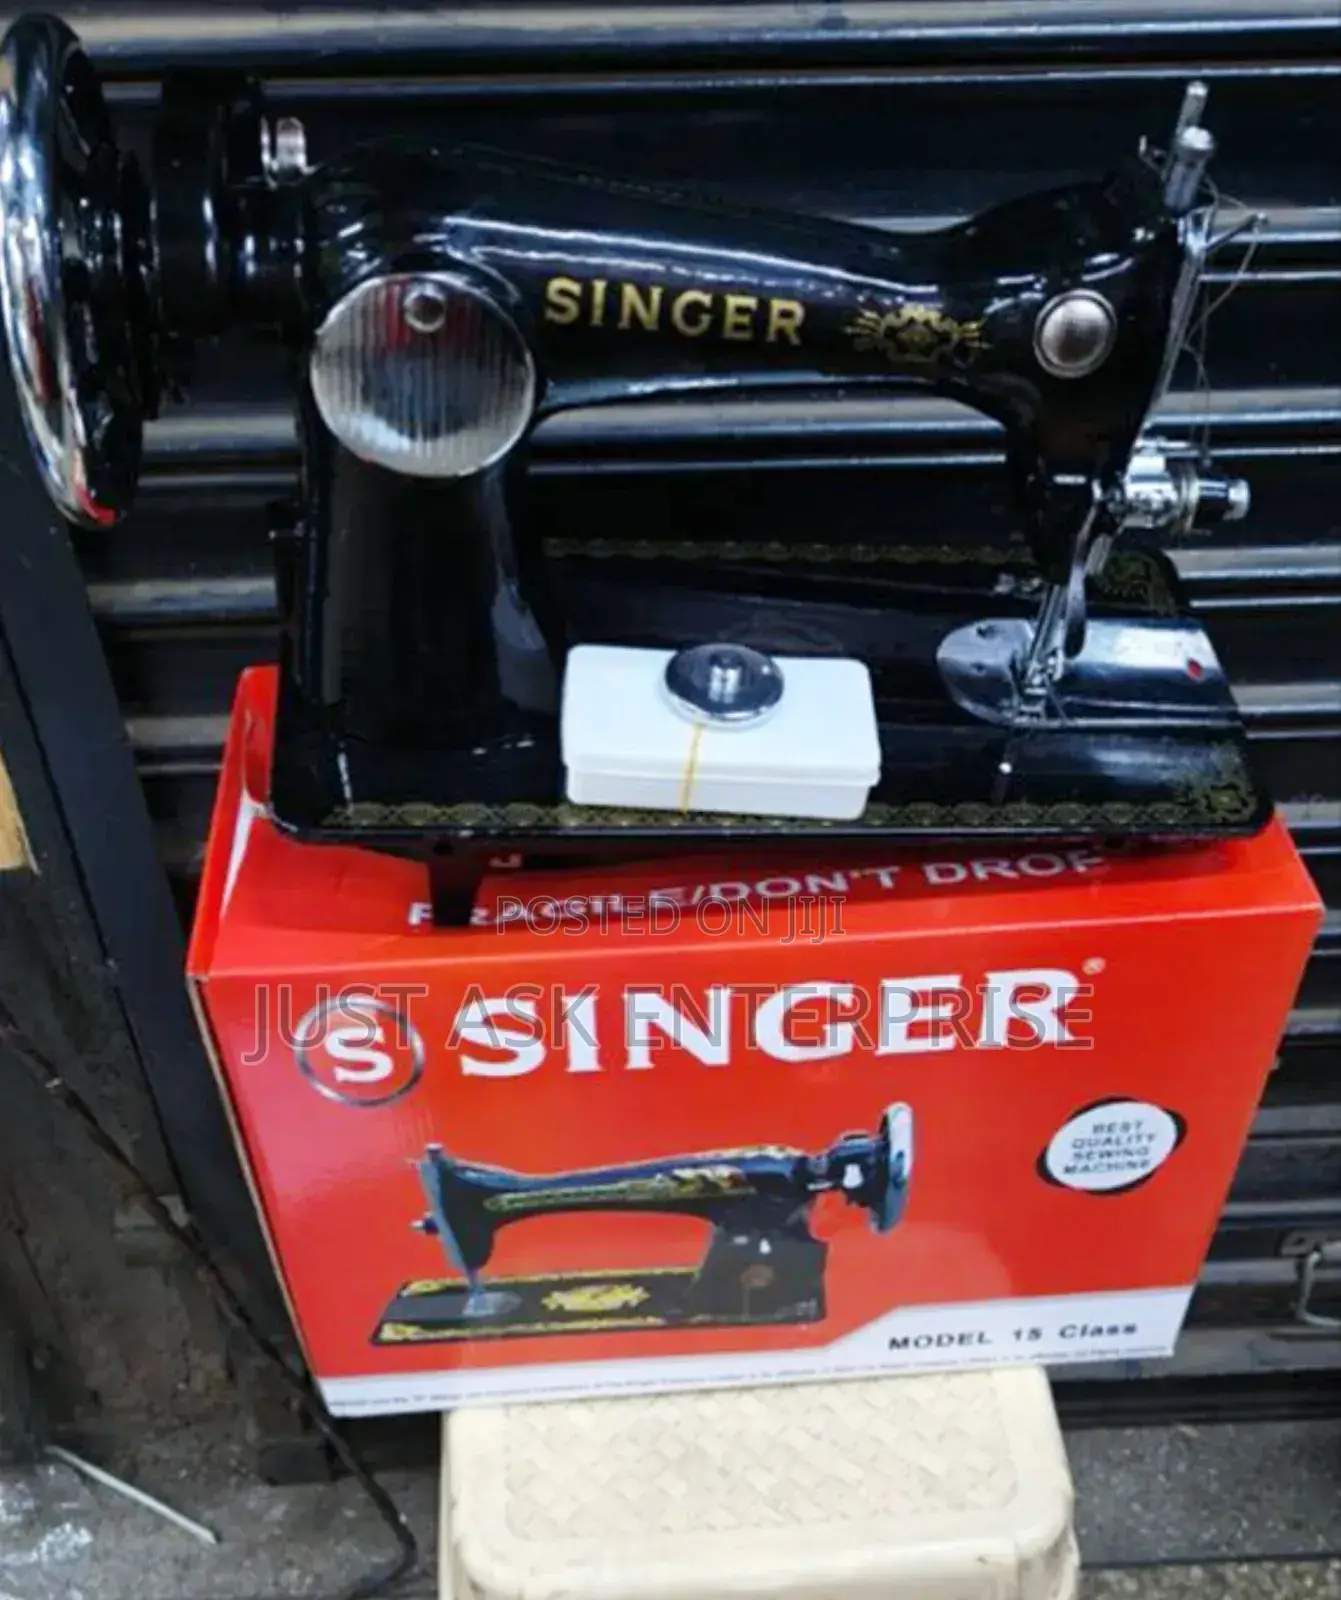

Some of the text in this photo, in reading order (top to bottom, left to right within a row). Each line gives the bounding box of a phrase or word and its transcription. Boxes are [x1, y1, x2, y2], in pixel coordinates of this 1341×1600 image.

[545, 276, 805, 345] SINGER
[457, 968, 1079, 1078] SINGER
[1092, 1120, 1143, 1134] BEST
[1071, 1133, 1156, 1149] QUALITY
[1072, 1147, 1150, 1162] SEWING
[888, 1330, 993, 1350] MODEL
[1059, 1321, 1138, 1340] Class
